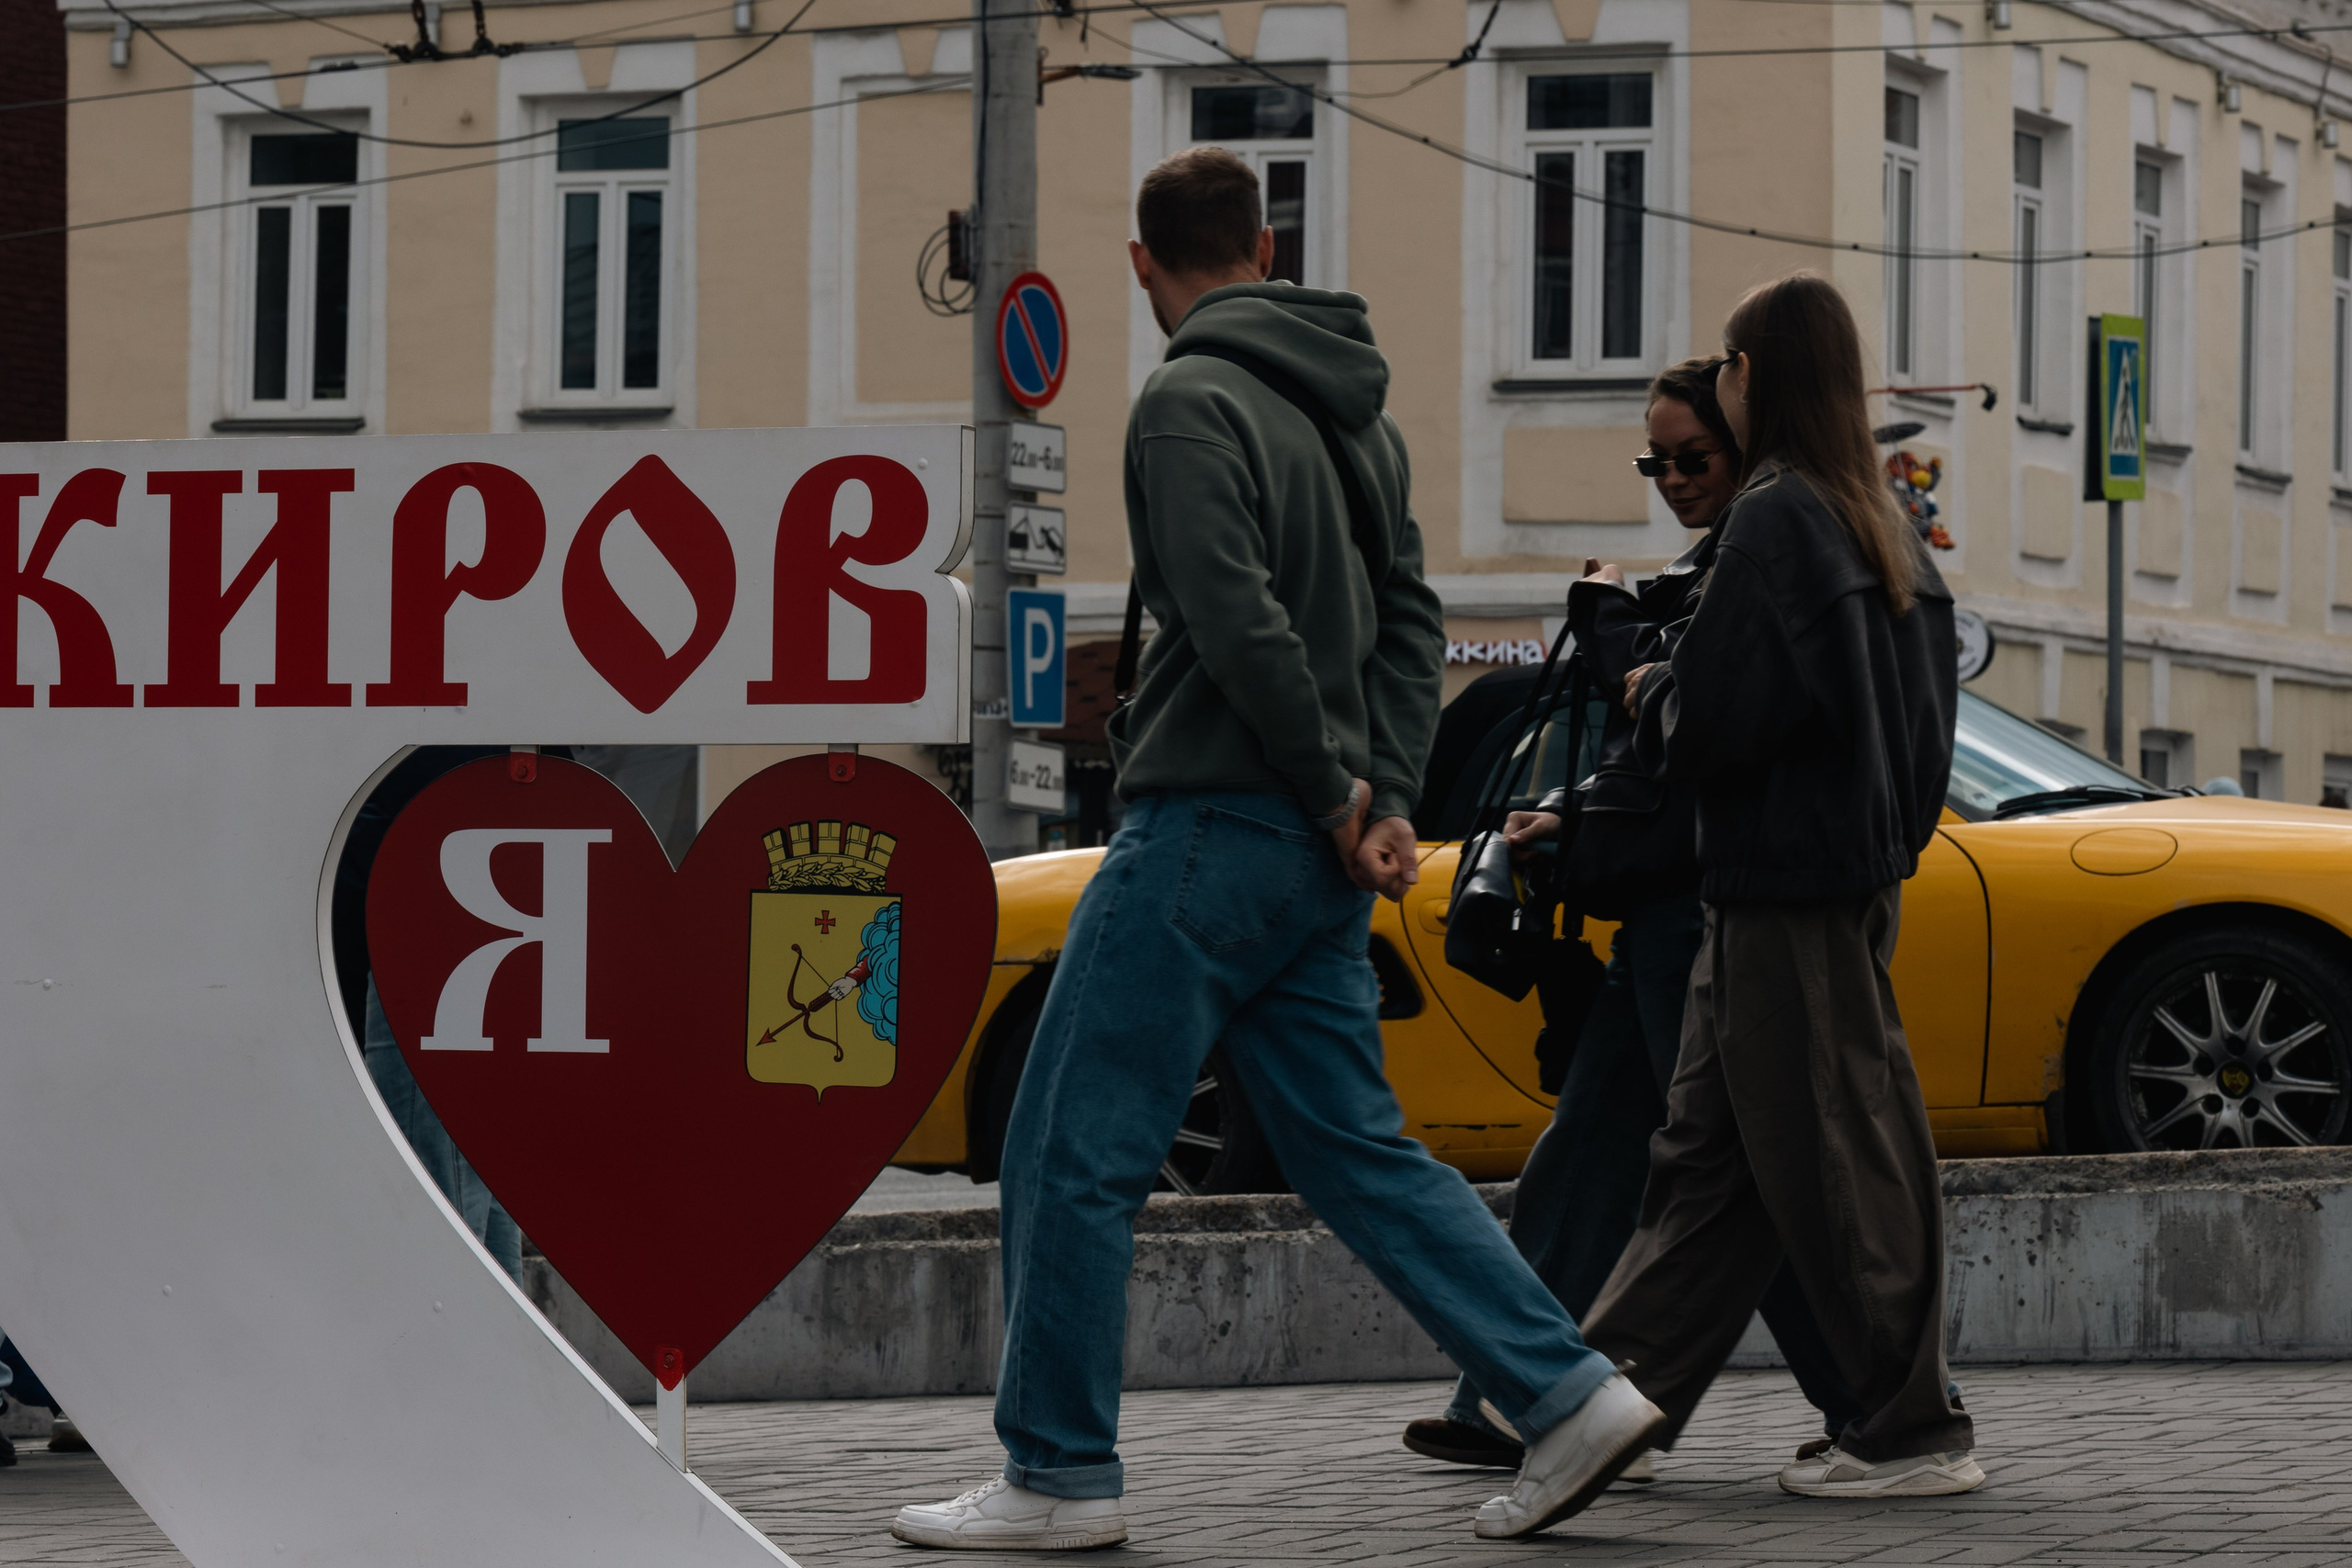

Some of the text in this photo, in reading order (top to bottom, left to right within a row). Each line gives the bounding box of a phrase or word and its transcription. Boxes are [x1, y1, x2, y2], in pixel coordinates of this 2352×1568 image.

[0, 454, 928, 715] КИРОВ
[1023, 606, 1056, 709] P
[420, 828, 613, 1054] Я
